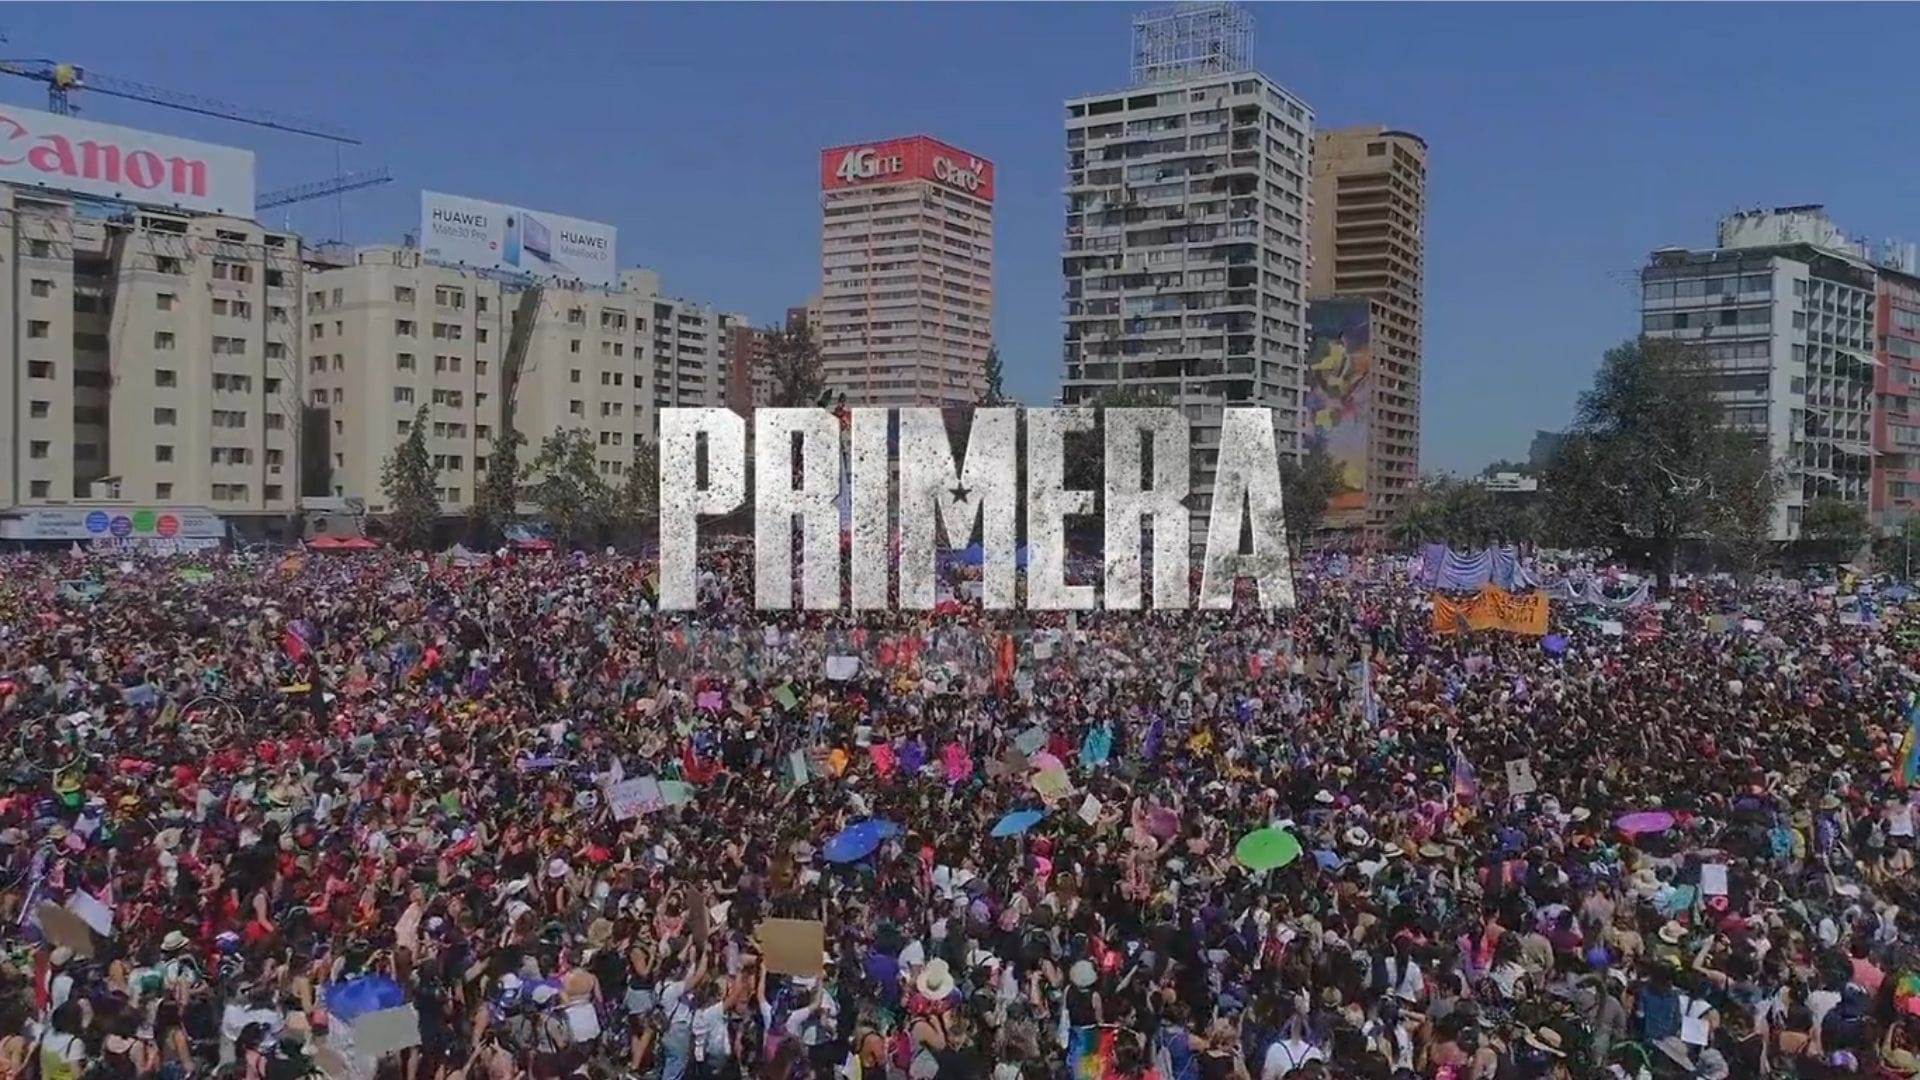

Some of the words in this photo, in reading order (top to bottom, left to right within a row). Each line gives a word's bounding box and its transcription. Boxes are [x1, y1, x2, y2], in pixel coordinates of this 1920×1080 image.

[933, 155, 981, 191] Claro
[433, 208, 487, 228] HUAWEI
[560, 230, 608, 249] HUAWEI
